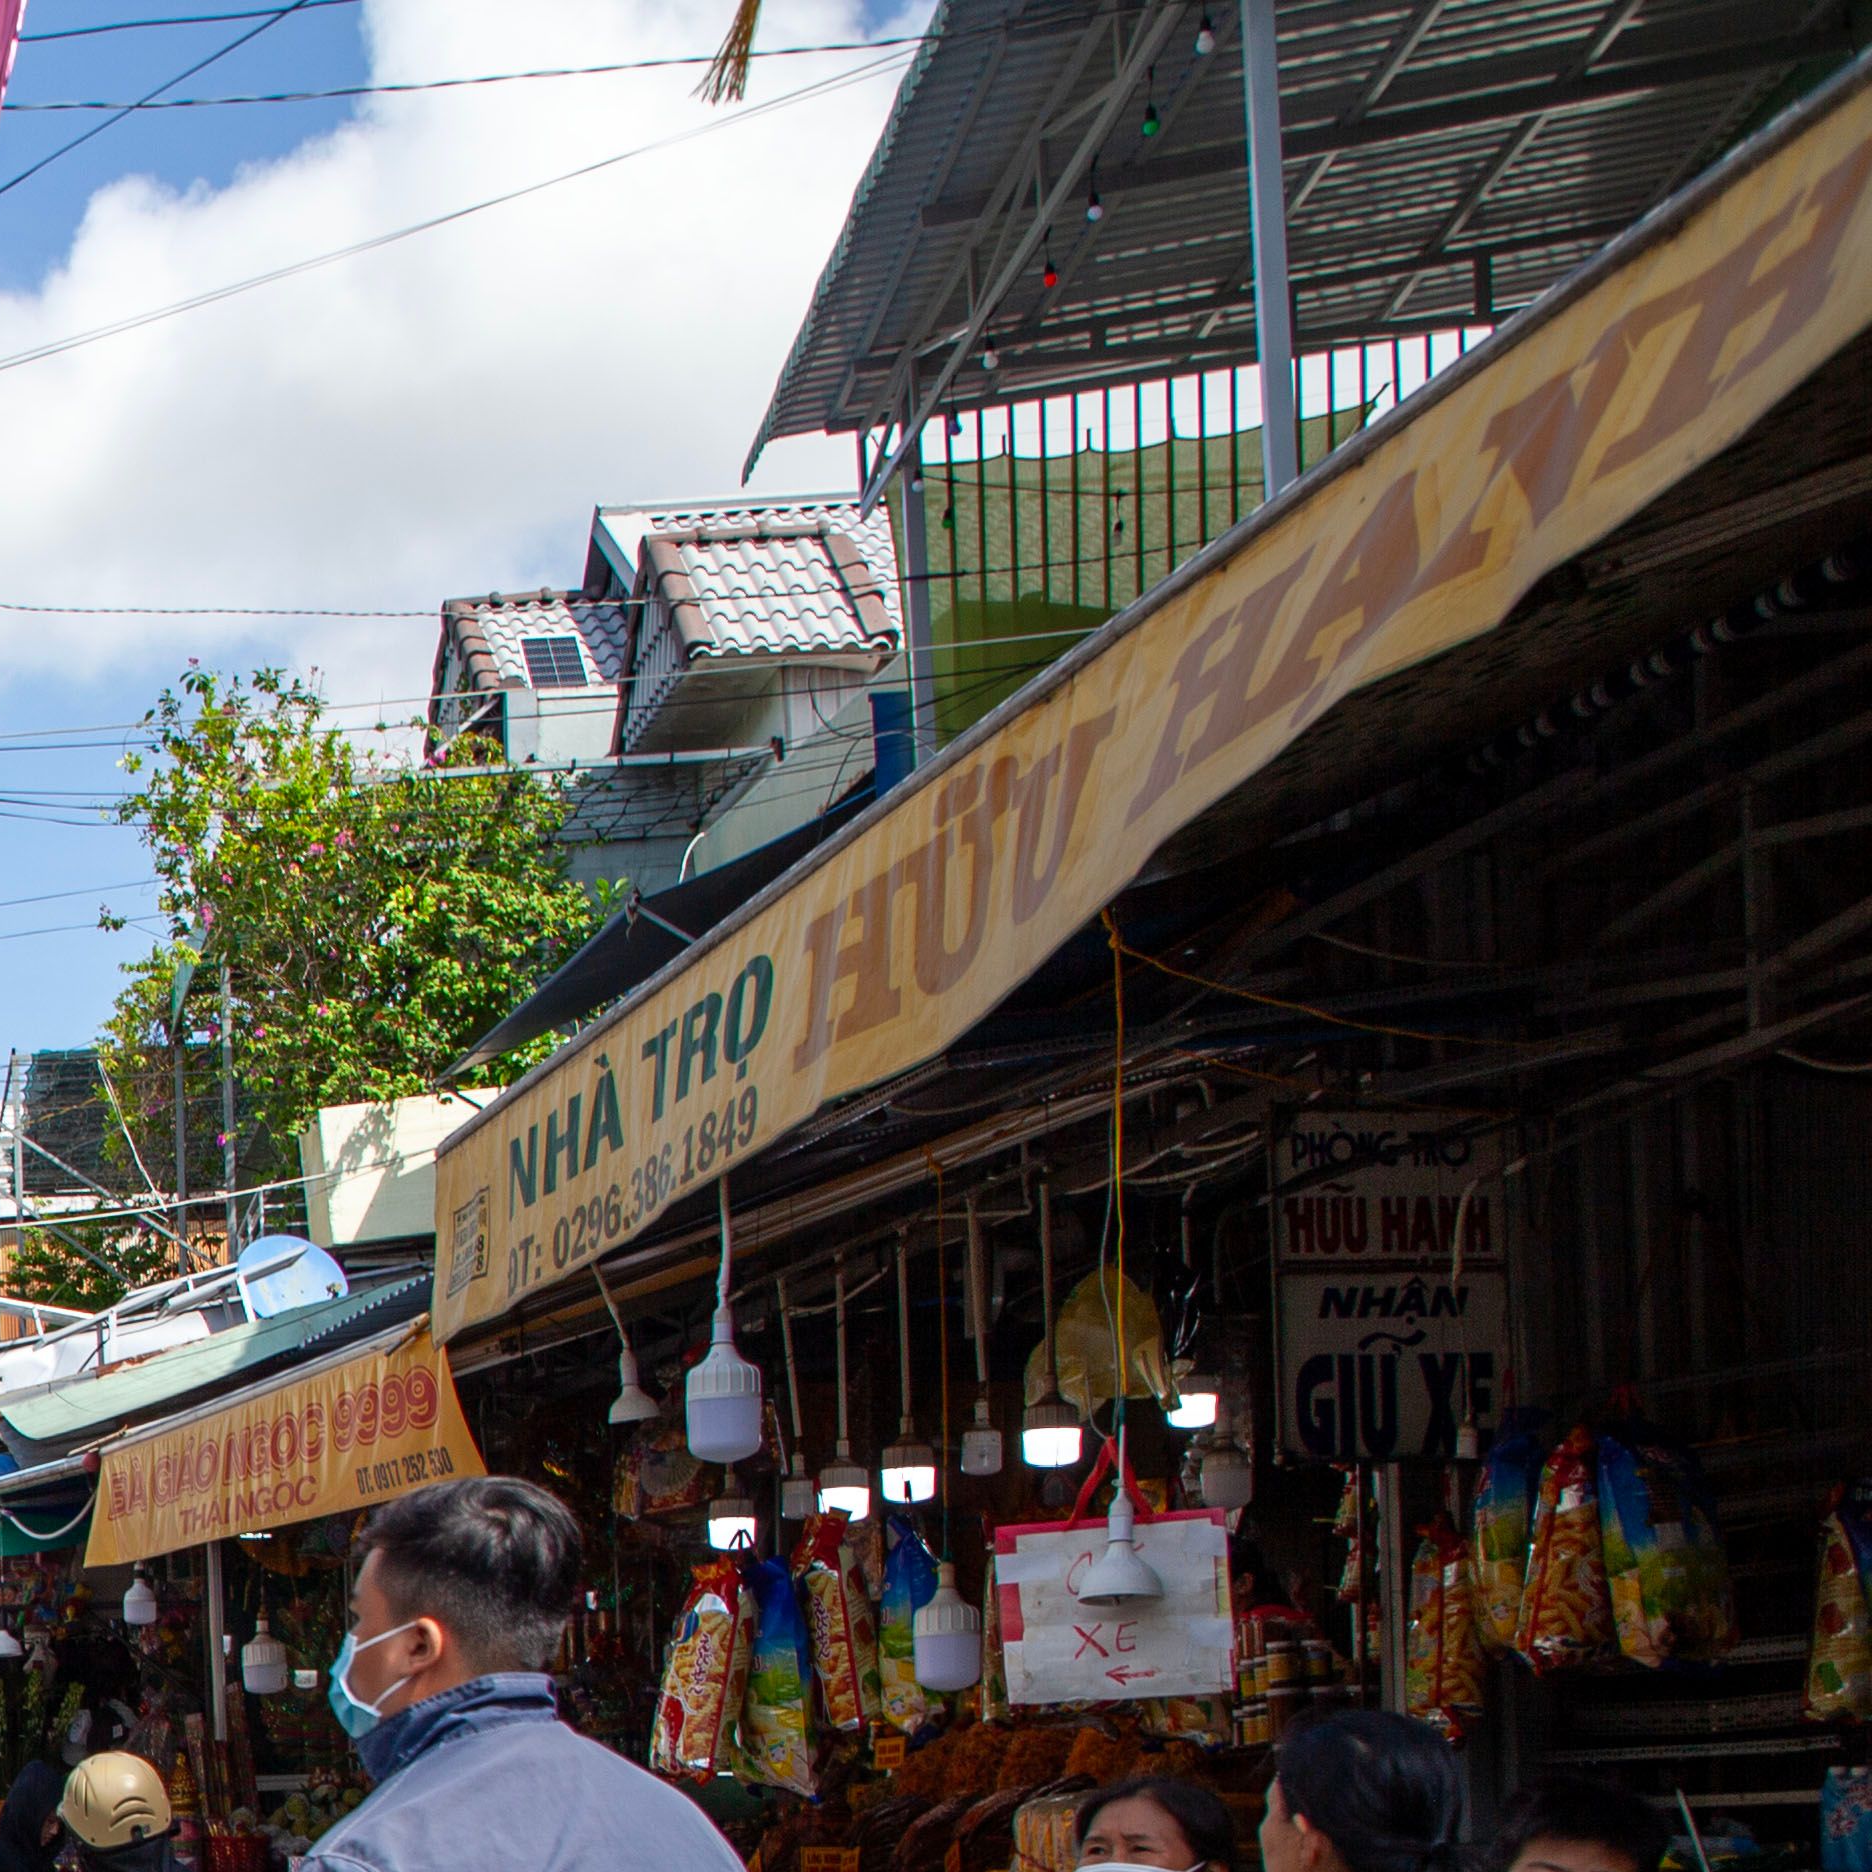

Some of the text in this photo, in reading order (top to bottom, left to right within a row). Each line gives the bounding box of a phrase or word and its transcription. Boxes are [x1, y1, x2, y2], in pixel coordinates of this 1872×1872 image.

[510, 1056, 624, 1221] NHÀ
[640, 953, 776, 1123] TRỌ
[552, 1085, 758, 1270] 0296.386.1849
[1290, 1122, 1472, 1170] PHÒNG TRỌ
[1282, 1182, 1492, 1265] HỮU HẠNH
[1318, 1277, 1468, 1324] NHẬN
[223, 1402, 326, 1486] NGỌC
[333, 1364, 439, 1452] 9999
[1295, 1328, 1494, 1461] GIỮ XE
[373, 1459, 402, 1490] 0917
[403, 1453, 427, 1484] 252
[429, 1446, 454, 1477] 530
[180, 1475, 317, 1535] THÁI NGỌC
[1072, 1620, 1140, 1660] XE
